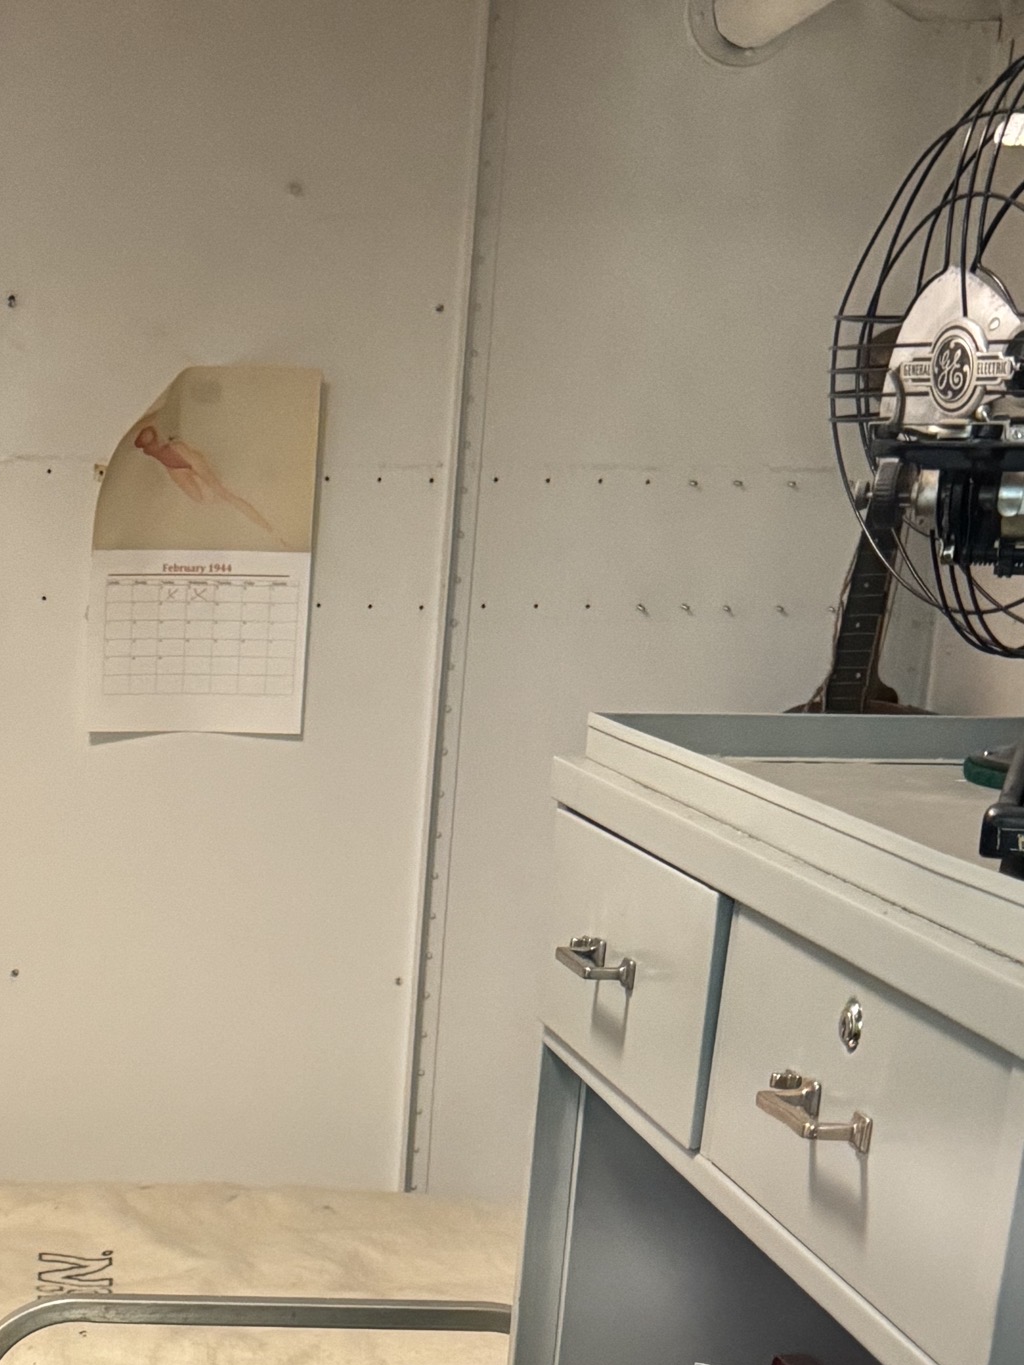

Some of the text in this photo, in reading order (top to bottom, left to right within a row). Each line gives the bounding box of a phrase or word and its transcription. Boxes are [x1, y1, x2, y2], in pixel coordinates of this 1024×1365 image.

[903, 362, 1008, 377] GENERAL ELECTRIC
[162, 563, 232, 574] February 1944
